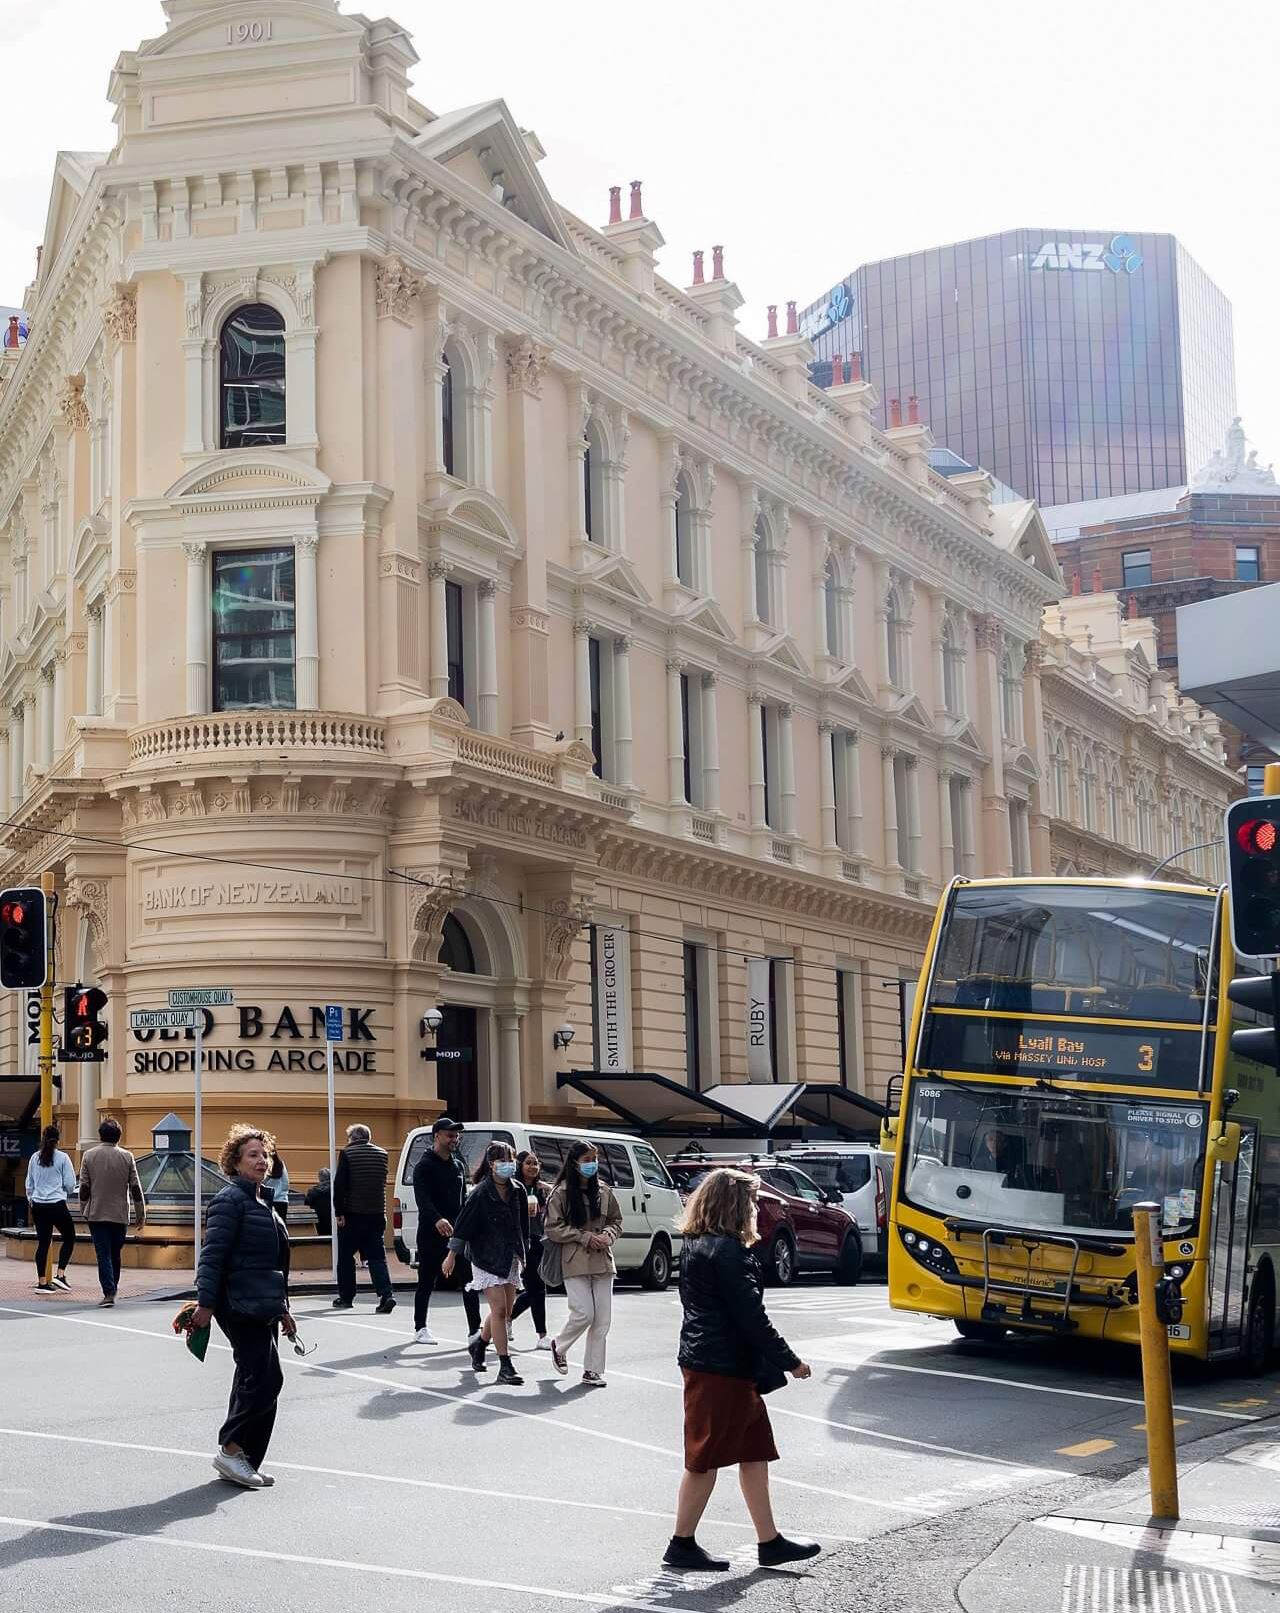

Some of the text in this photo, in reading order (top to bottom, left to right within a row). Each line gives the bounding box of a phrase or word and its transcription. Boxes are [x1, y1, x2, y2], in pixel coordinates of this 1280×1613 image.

[225, 18, 273, 46] 1901
[1031, 242, 1105, 272] ANZ
[144, 886, 187, 911] BANK
[189, 884, 215, 907] OF
[217, 882, 261, 906] NEW
[172, 990, 212, 1005] CUSTOMHOUSE
[604, 932, 619, 1067] SMITH THE GROCER
[135, 1012, 189, 1027] LAMBTON QUAY
[236, 1005, 377, 1041] BANK
[750, 997, 766, 1047] RUBY
[1019, 1034, 1084, 1053] Lyall Bay
[134, 1049, 377, 1074] SHOPPING ARCADE
[435, 1051, 461, 1059] MOJO
[1014, 1051, 1053, 1064] MASSEY
[1137, 1044, 1154, 1071] 3
[919, 1089, 941, 1098] 5086
[1127, 1109, 1182, 1119] PLEASE SIGNAL
[1127, 1115, 1153, 1123] DRIVER
